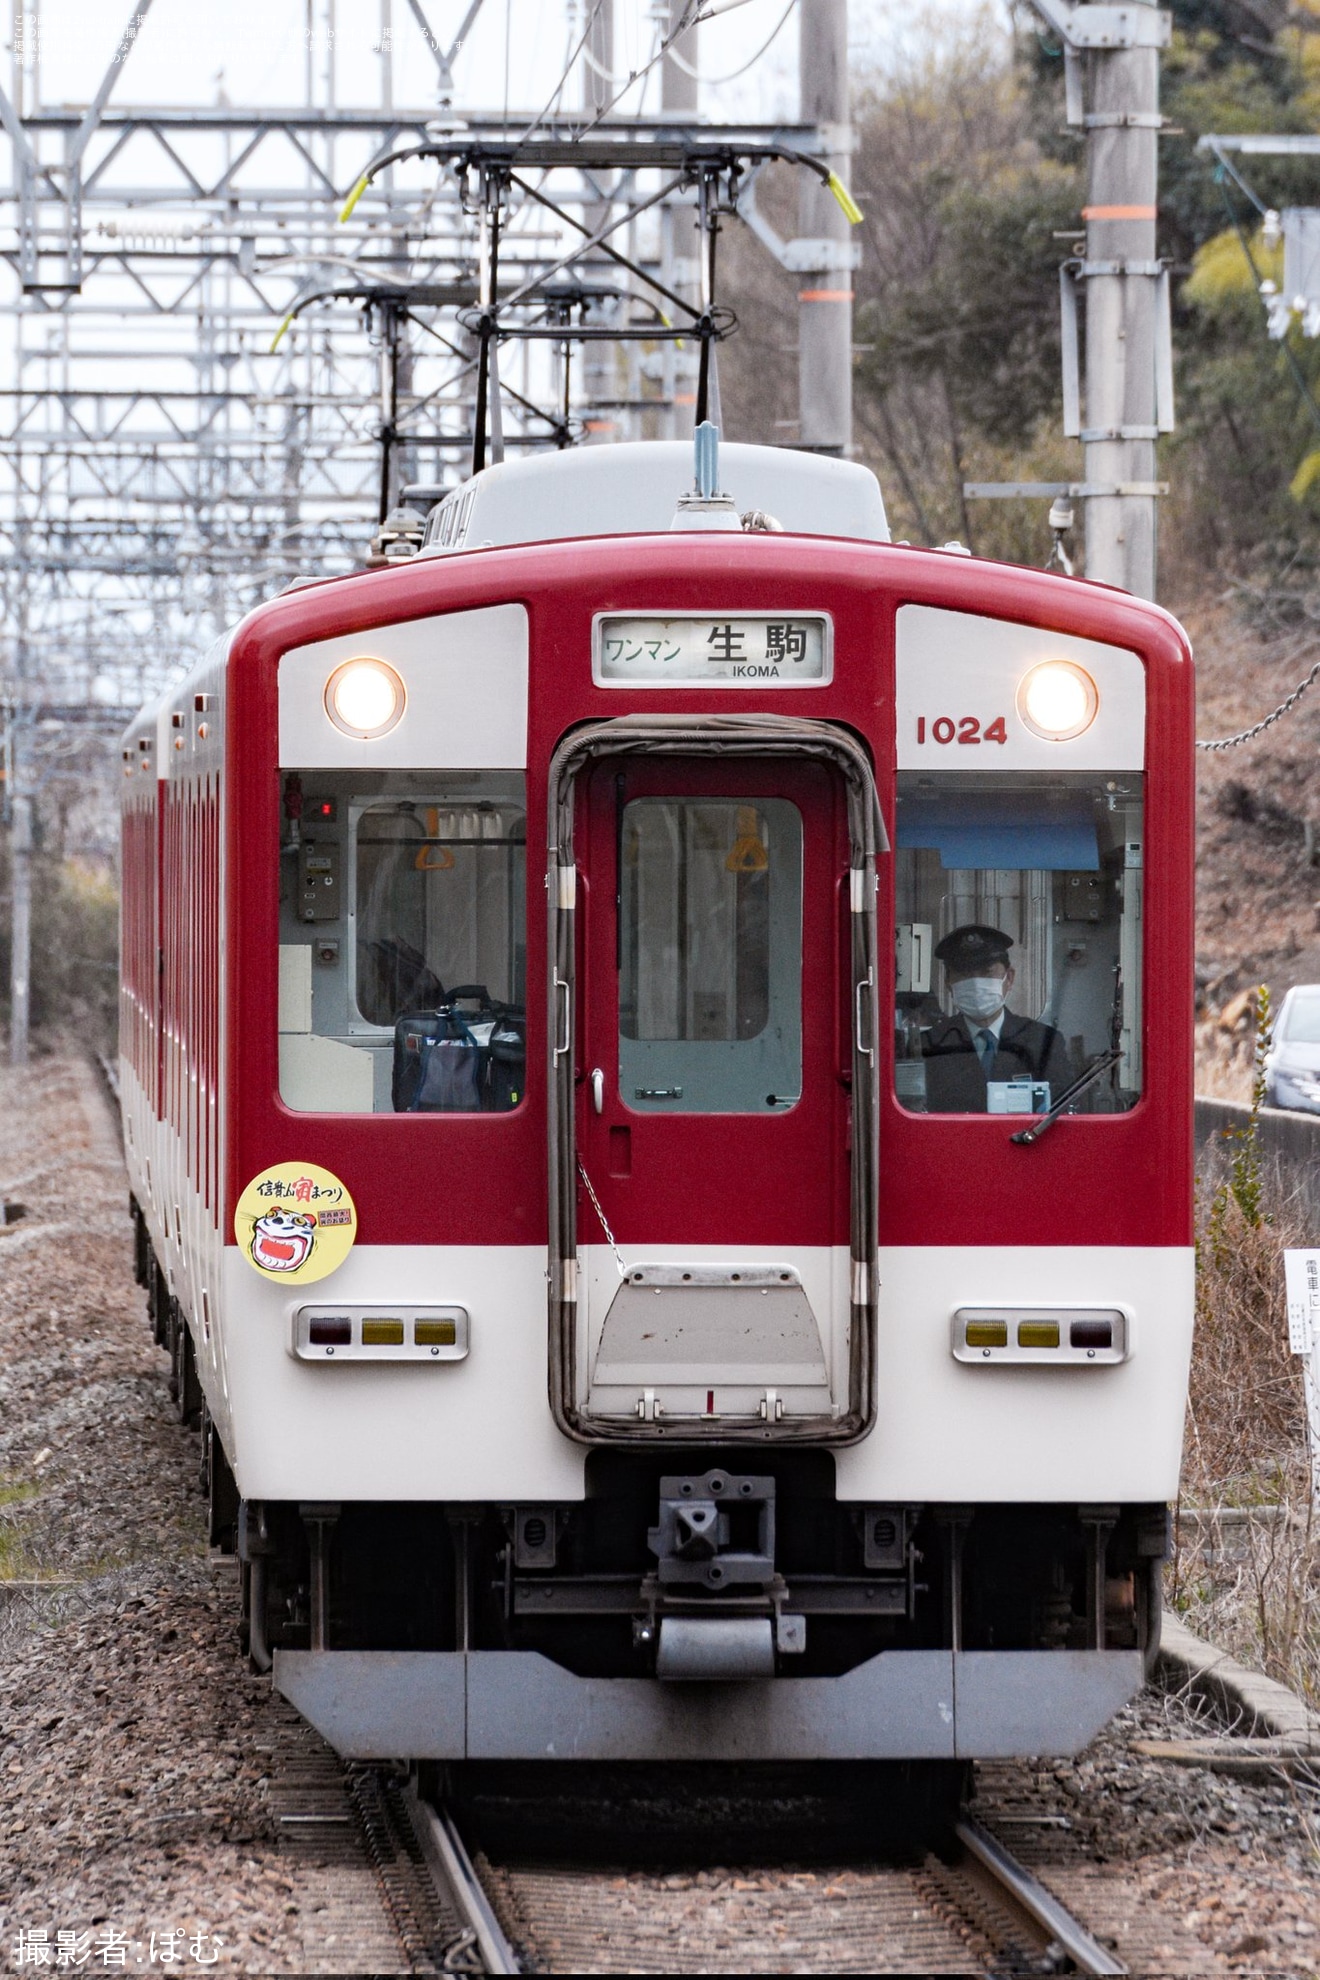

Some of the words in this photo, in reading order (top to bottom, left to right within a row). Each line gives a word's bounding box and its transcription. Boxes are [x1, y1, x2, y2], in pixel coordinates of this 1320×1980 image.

[605, 639, 682, 662] ワンマン
[707, 624, 807, 663] 生駒
[733, 665, 780, 678] IKOMA
[917, 716, 1008, 745] 1024
